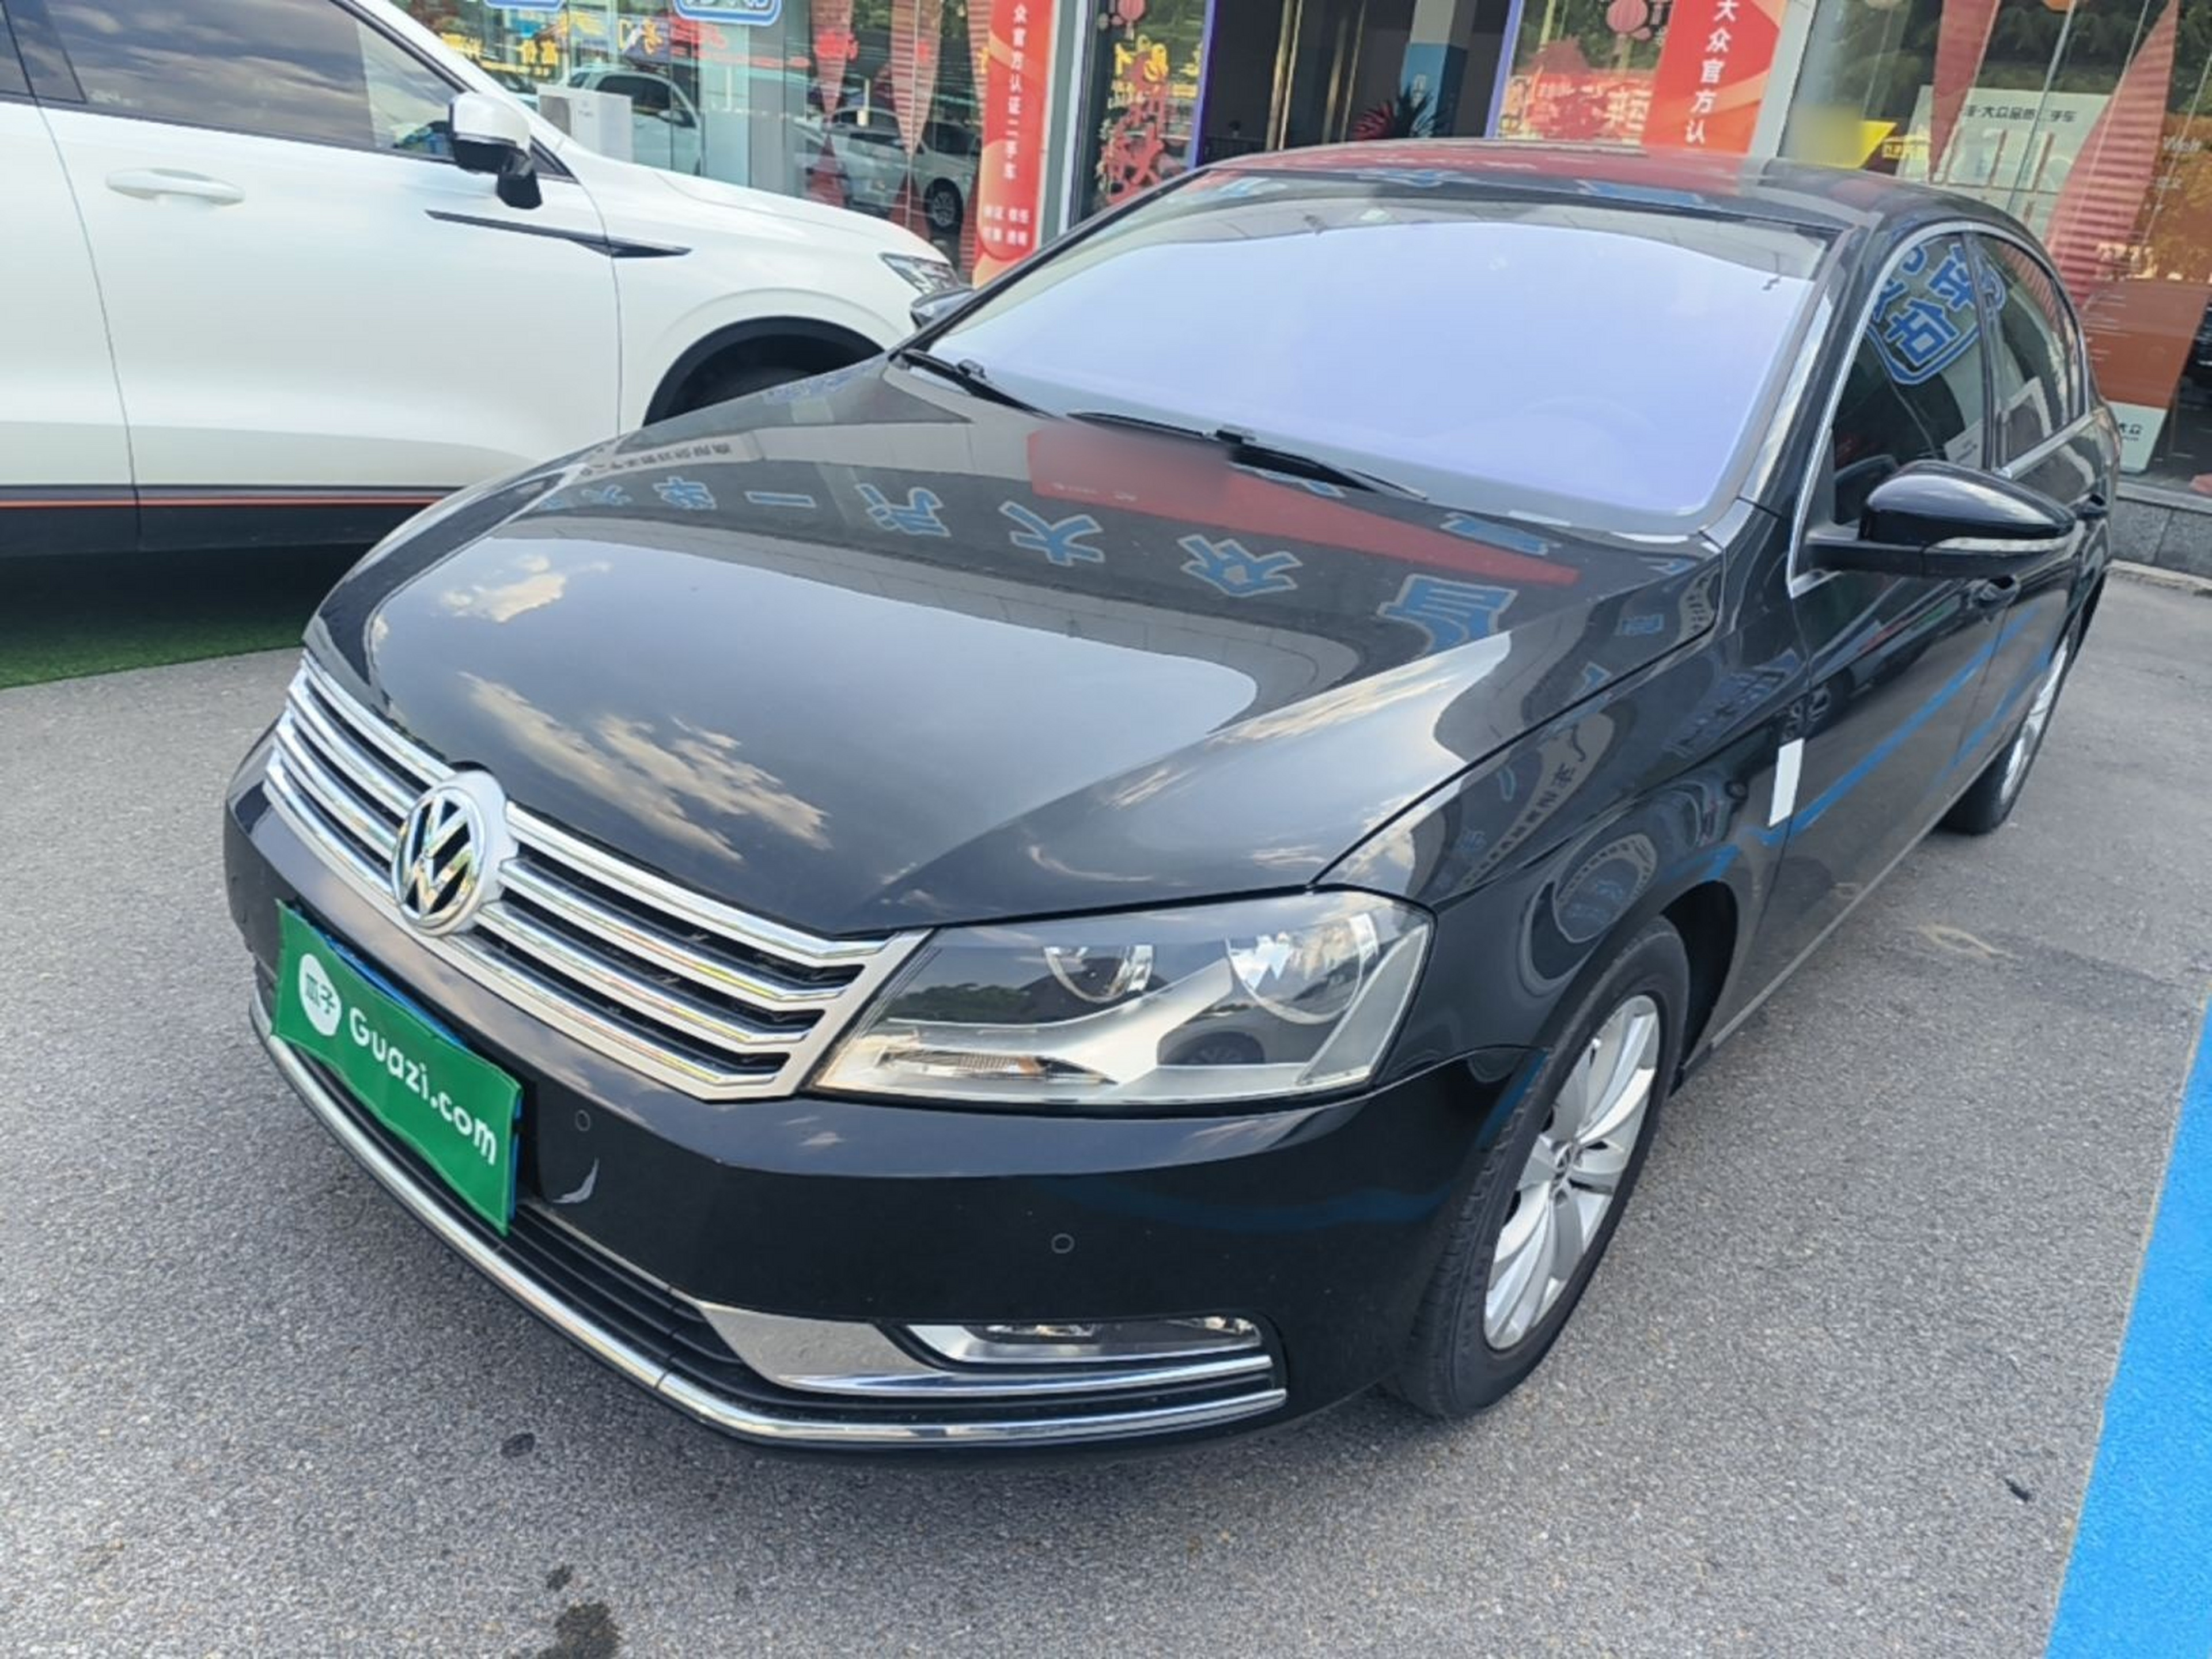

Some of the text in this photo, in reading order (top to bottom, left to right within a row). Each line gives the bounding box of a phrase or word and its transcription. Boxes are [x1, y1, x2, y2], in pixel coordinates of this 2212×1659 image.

[1685, 0, 1740, 144] 大众官方认
[349, 1007, 497, 1165] Guazi.com
